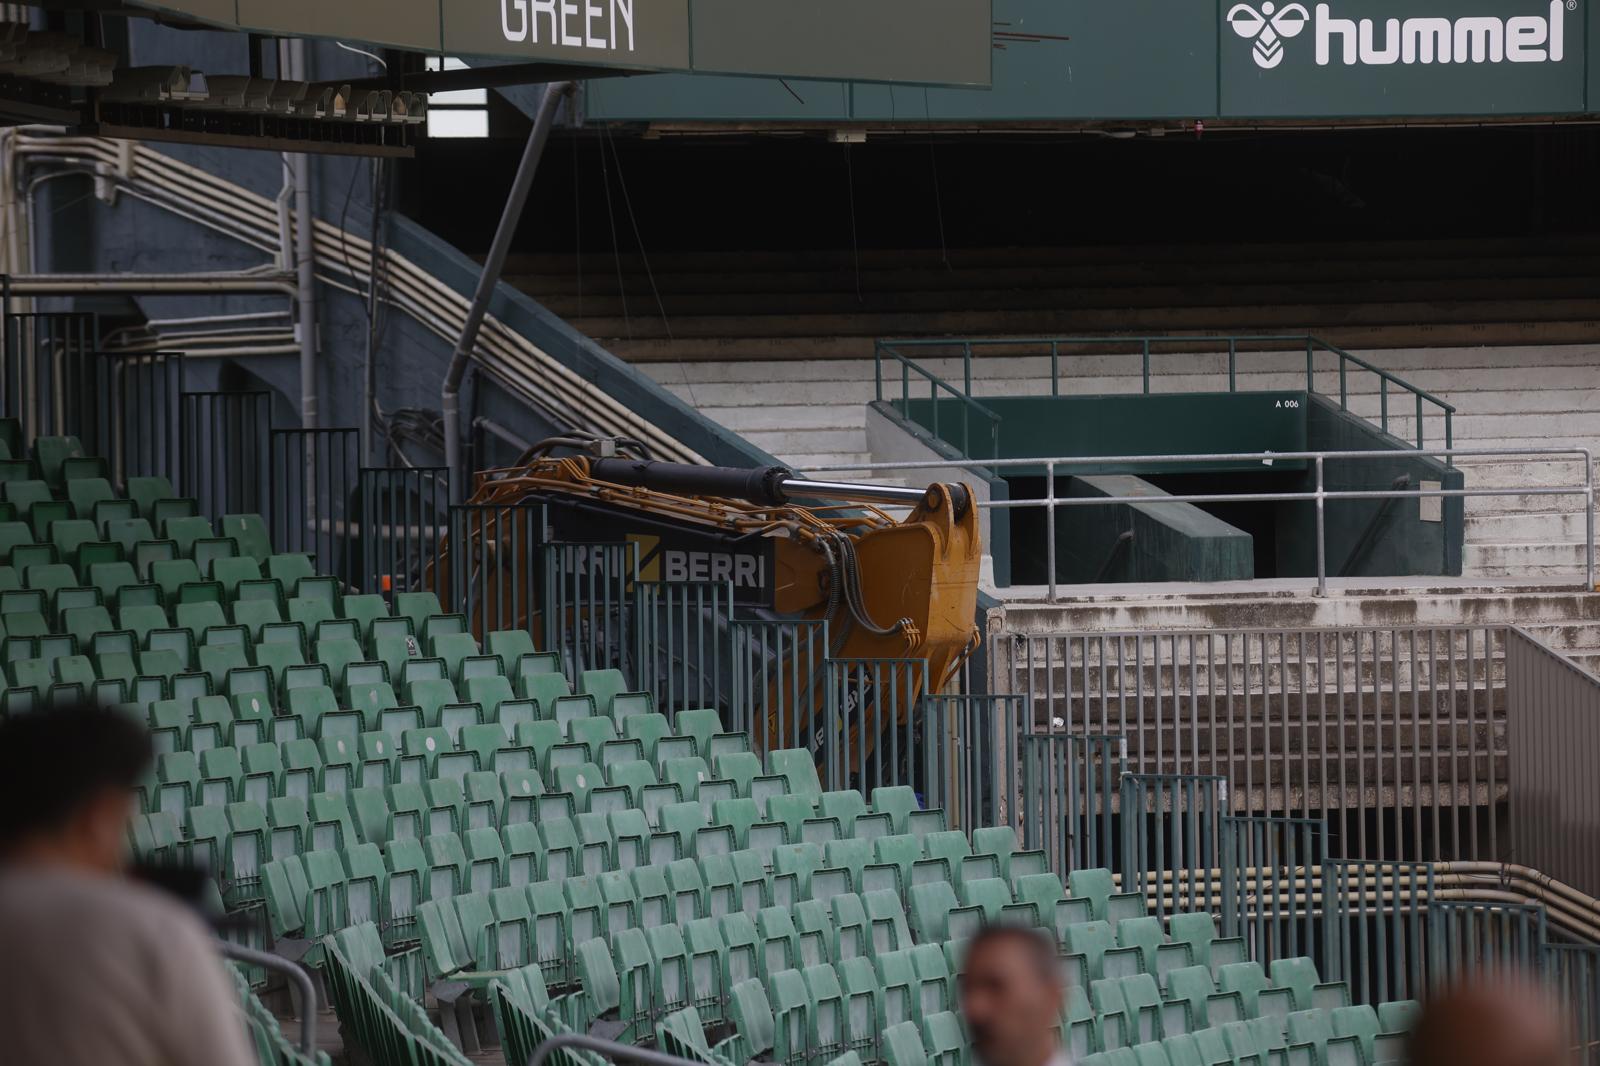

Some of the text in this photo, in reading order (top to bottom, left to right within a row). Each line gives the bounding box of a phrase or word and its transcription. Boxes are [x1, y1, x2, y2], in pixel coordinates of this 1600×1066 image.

[501, 0, 634, 51] GREEN
[1315, 0, 1564, 66] hummel
[1275, 400, 1299, 408] A 006
[665, 550, 766, 588] BERRI
